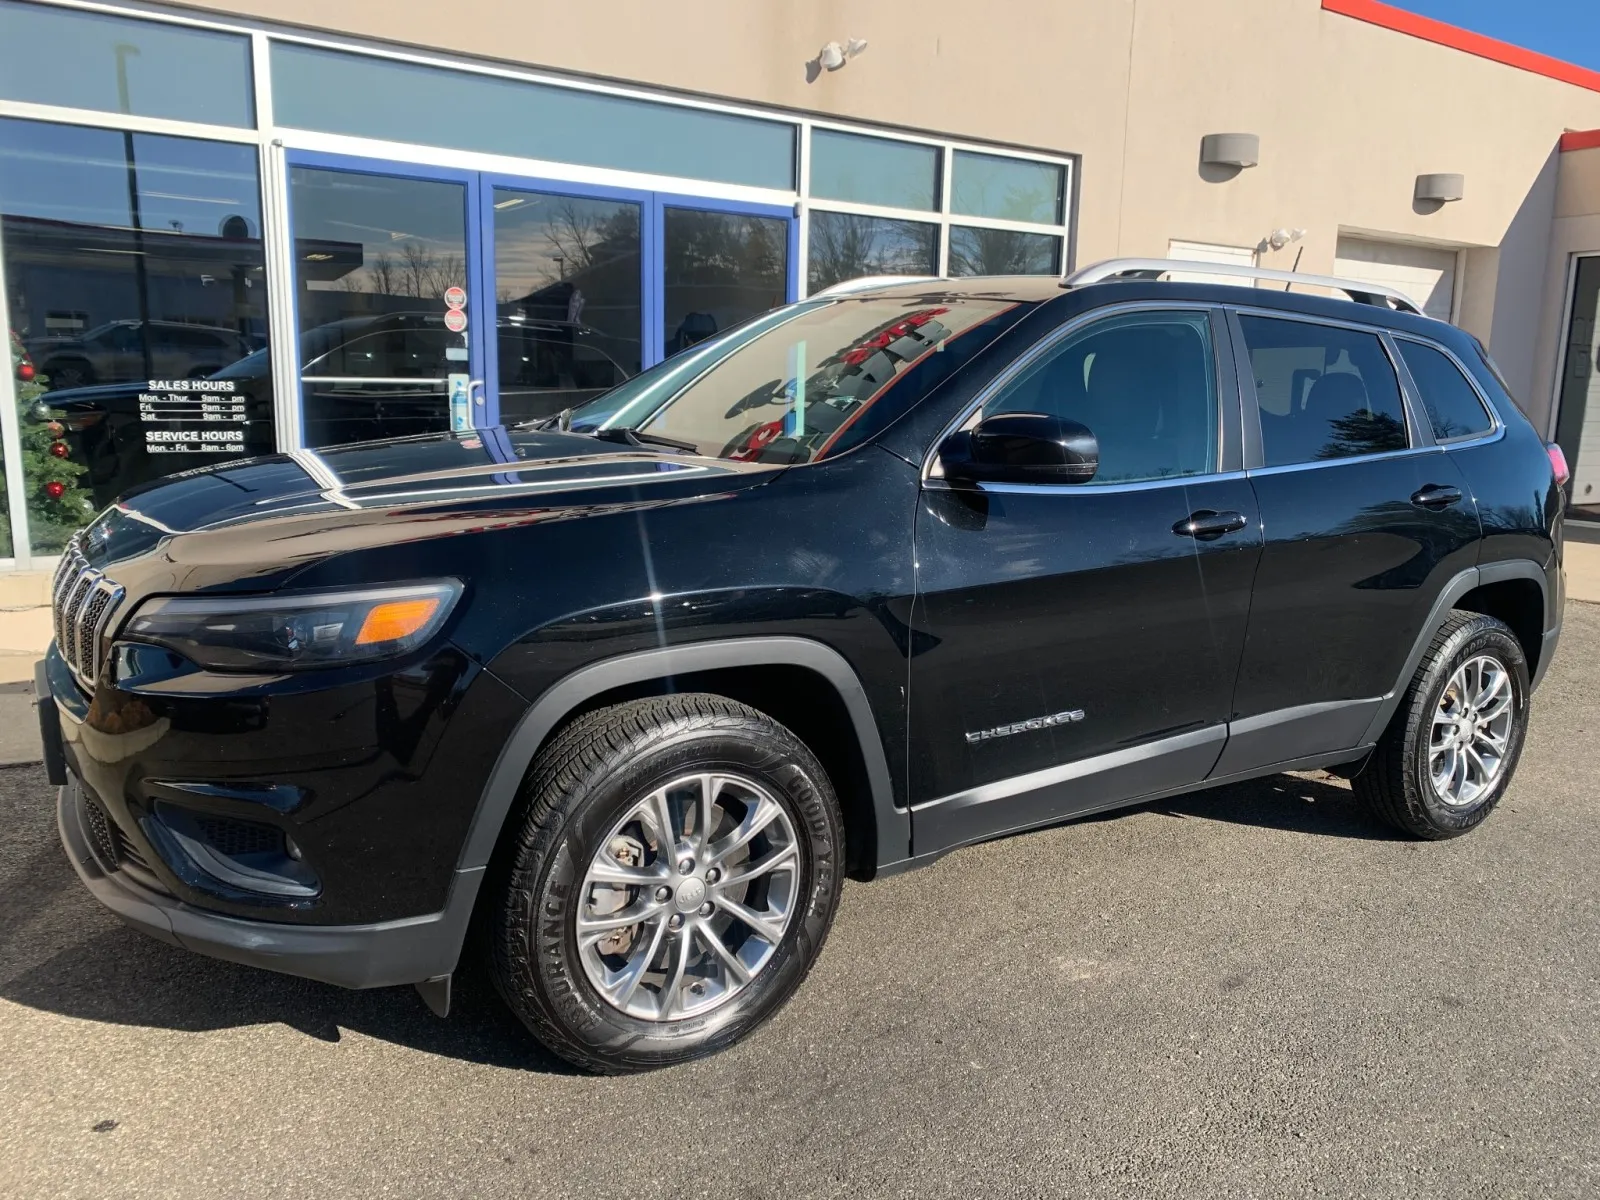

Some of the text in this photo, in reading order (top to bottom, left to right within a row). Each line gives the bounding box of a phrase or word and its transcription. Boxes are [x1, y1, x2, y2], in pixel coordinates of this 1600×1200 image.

[148, 380, 235, 391] SALES HOURS
[138, 394, 160, 402] Mon.
[168, 393, 190, 402] Thur.
[201, 394, 220, 402] 9am
[140, 403, 154, 411] Fri.
[201, 403, 220, 411] 9am
[140, 412, 158, 420] Sat.
[145, 431, 243, 441] SERVICE HOURS
[146, 444, 168, 452] Mon.
[175, 444, 189, 452] Fri.
[226, 444, 244, 452] 6pm
[965, 709, 1085, 743] CHEROKEE
